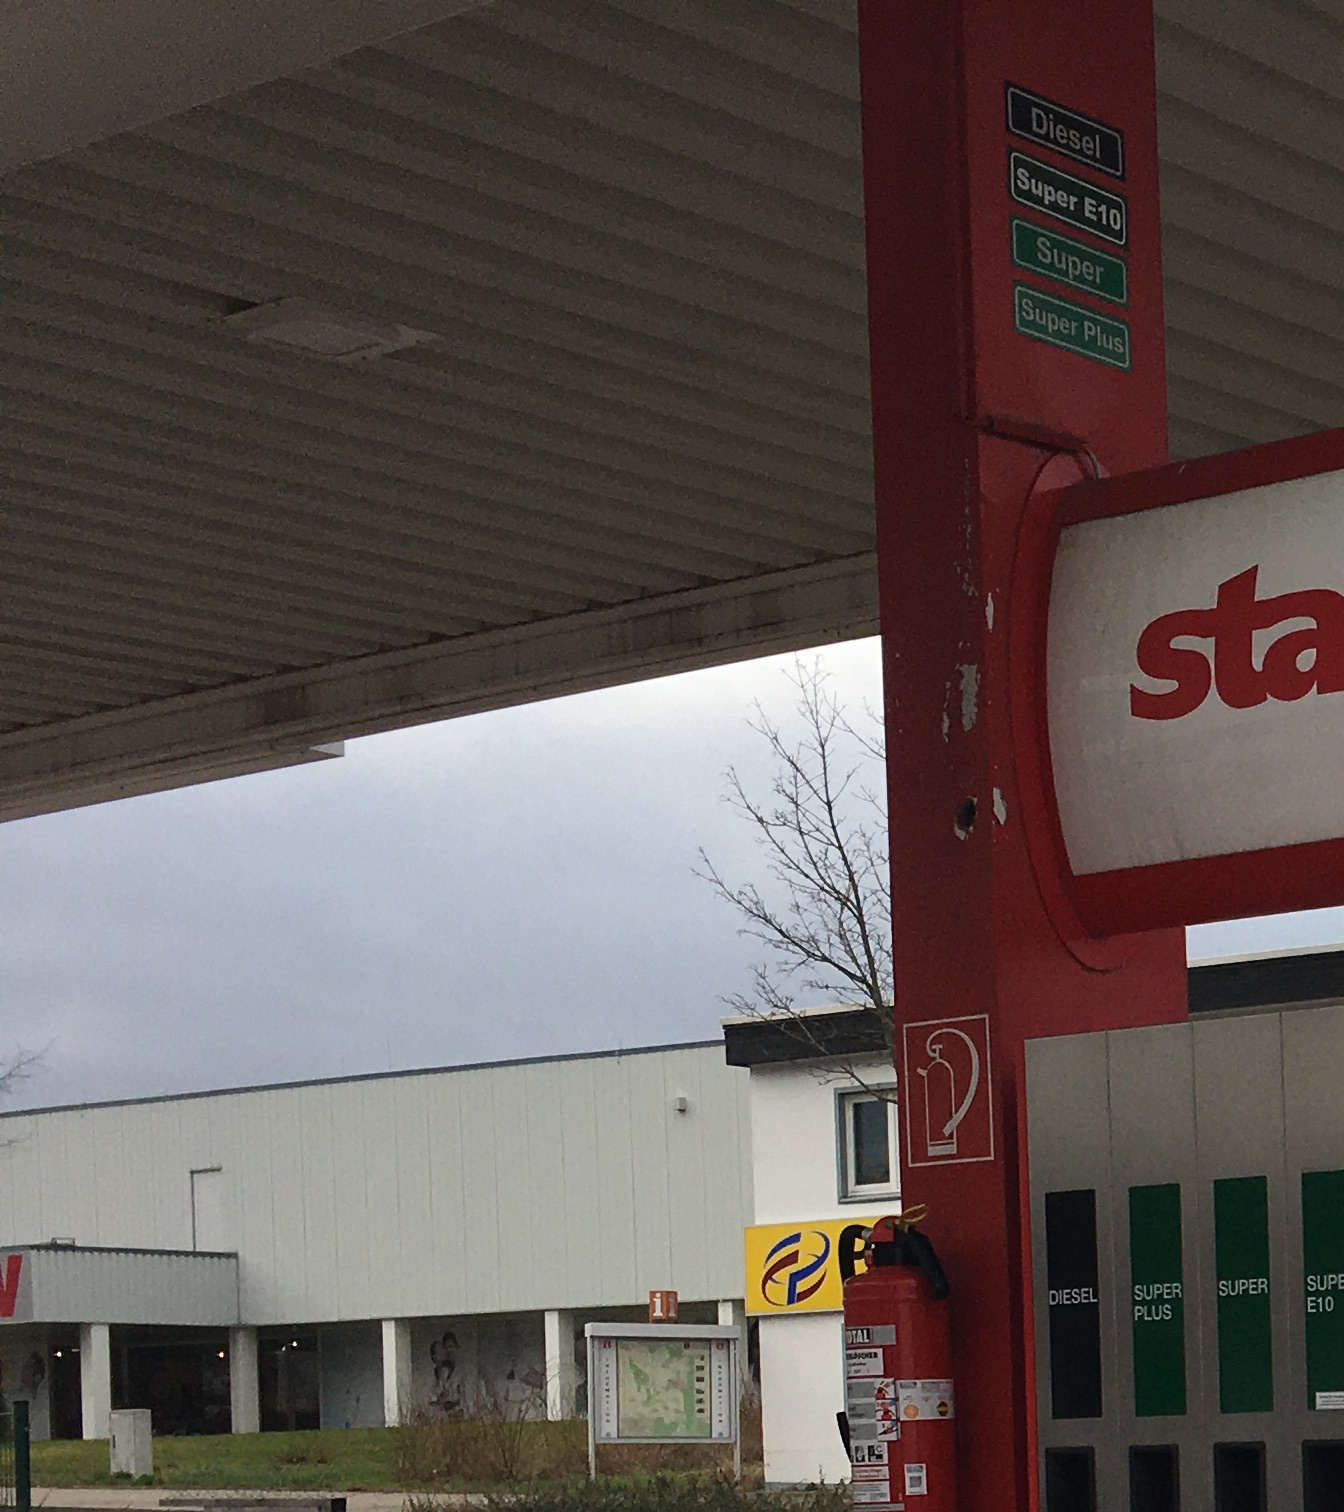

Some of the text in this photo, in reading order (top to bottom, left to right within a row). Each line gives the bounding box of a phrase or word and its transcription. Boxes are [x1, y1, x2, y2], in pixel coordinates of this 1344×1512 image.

[1031, 107, 1100, 159] Diesel
[1016, 168, 1121, 231] Super E10
[1037, 237, 1104, 284] Super
[1021, 298, 1124, 354] Super Plus
[1049, 1287, 1098, 1306] DIESEL
[1134, 1282, 1182, 1301] SUPER
[1218, 1278, 1269, 1297] SUPER
[1134, 1304, 1172, 1321] PLUS
[1306, 1296, 1334, 1314] E10
[846, 1329, 870, 1345] OTAL
